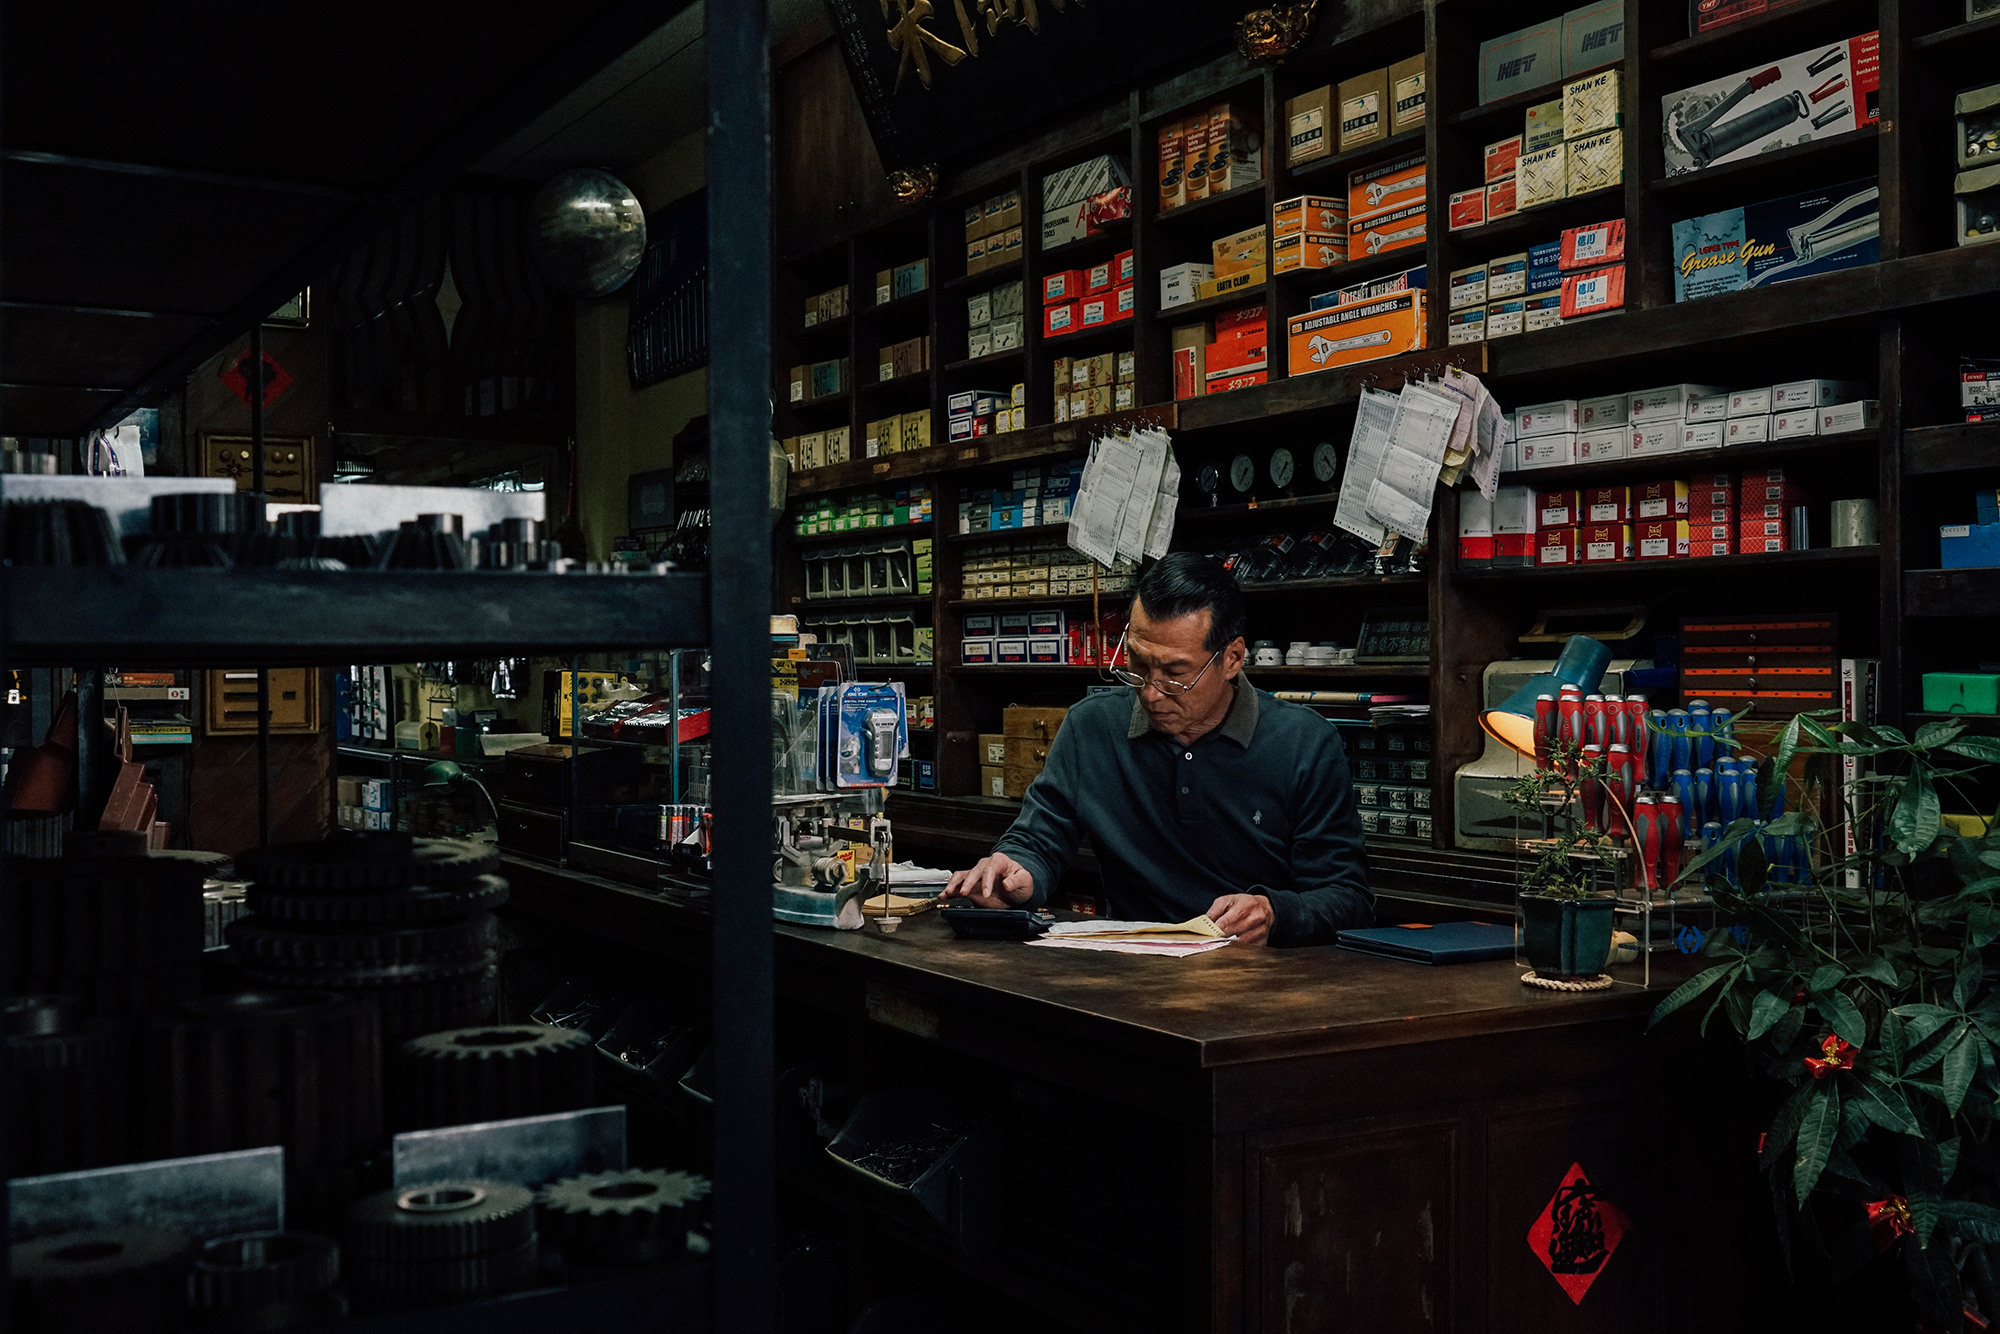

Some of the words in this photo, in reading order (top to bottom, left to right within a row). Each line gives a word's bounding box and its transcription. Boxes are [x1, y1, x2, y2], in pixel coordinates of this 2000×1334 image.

[1702, 0, 1716, 10] YMT
[1570, 79, 1594, 96] SHAN
[1595, 75, 1607, 88] KE
[1574, 141, 1596, 153] SHAN
[1600, 135, 1611, 146] KE
[1522, 154, 1544, 167] SHAN
[1546, 149, 1557, 160] KE
[1044, 216, 1069, 229] PROFESSIONAL
[1364, 217, 1391, 230] ADJUSTABLE
[1392, 210, 1406, 222] ANGLE
[1044, 229, 1055, 238] TOOLS
[1236, 236, 1247, 245] LONG
[1247, 232, 1258, 241] NOSE
[1699, 244, 1721, 255] LEVER
[1722, 240, 1740, 250] TYPE
[1681, 251, 1736, 279] Grease
[1740, 238, 1776, 267] Gun
[1217, 280, 1231, 292] EARTH
[1233, 274, 1250, 287] CLAMP
[1304, 313, 1340, 331] ADJUSTABLE
[1340, 309, 1361, 322] ANGLE
[1361, 300, 1398, 317] WRANCHES
